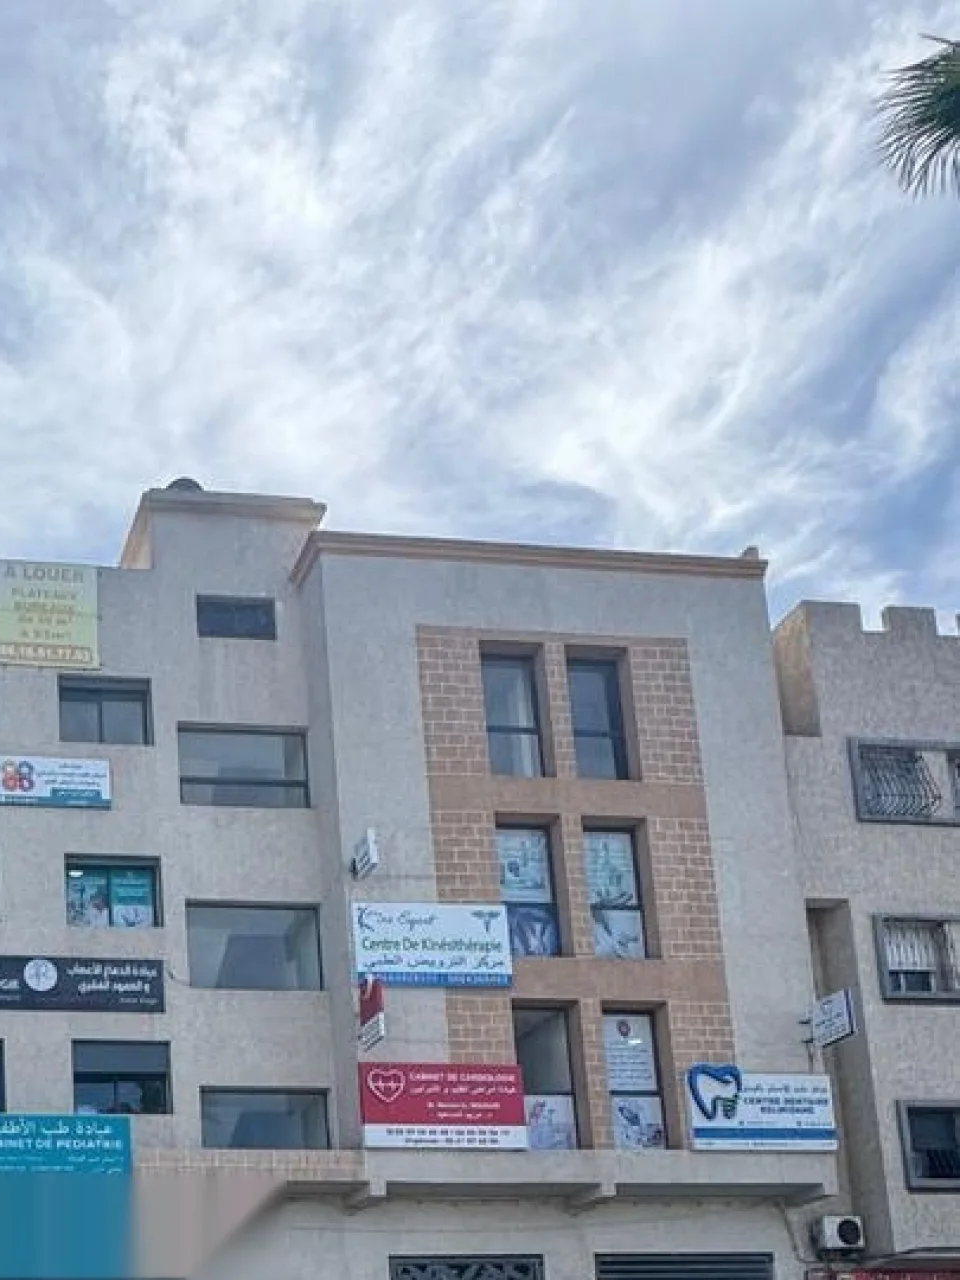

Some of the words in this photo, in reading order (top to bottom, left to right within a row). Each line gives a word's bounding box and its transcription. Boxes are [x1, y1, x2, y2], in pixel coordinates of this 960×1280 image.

[23, 568, 84, 583] LOUER
[362, 937, 401, 951] Centre
[402, 938, 419, 951] De
[743, 1096, 781, 1105] CENTRE
[42, 1119, 70, 1135] طب
[35, 1138, 53, 1150] DE
